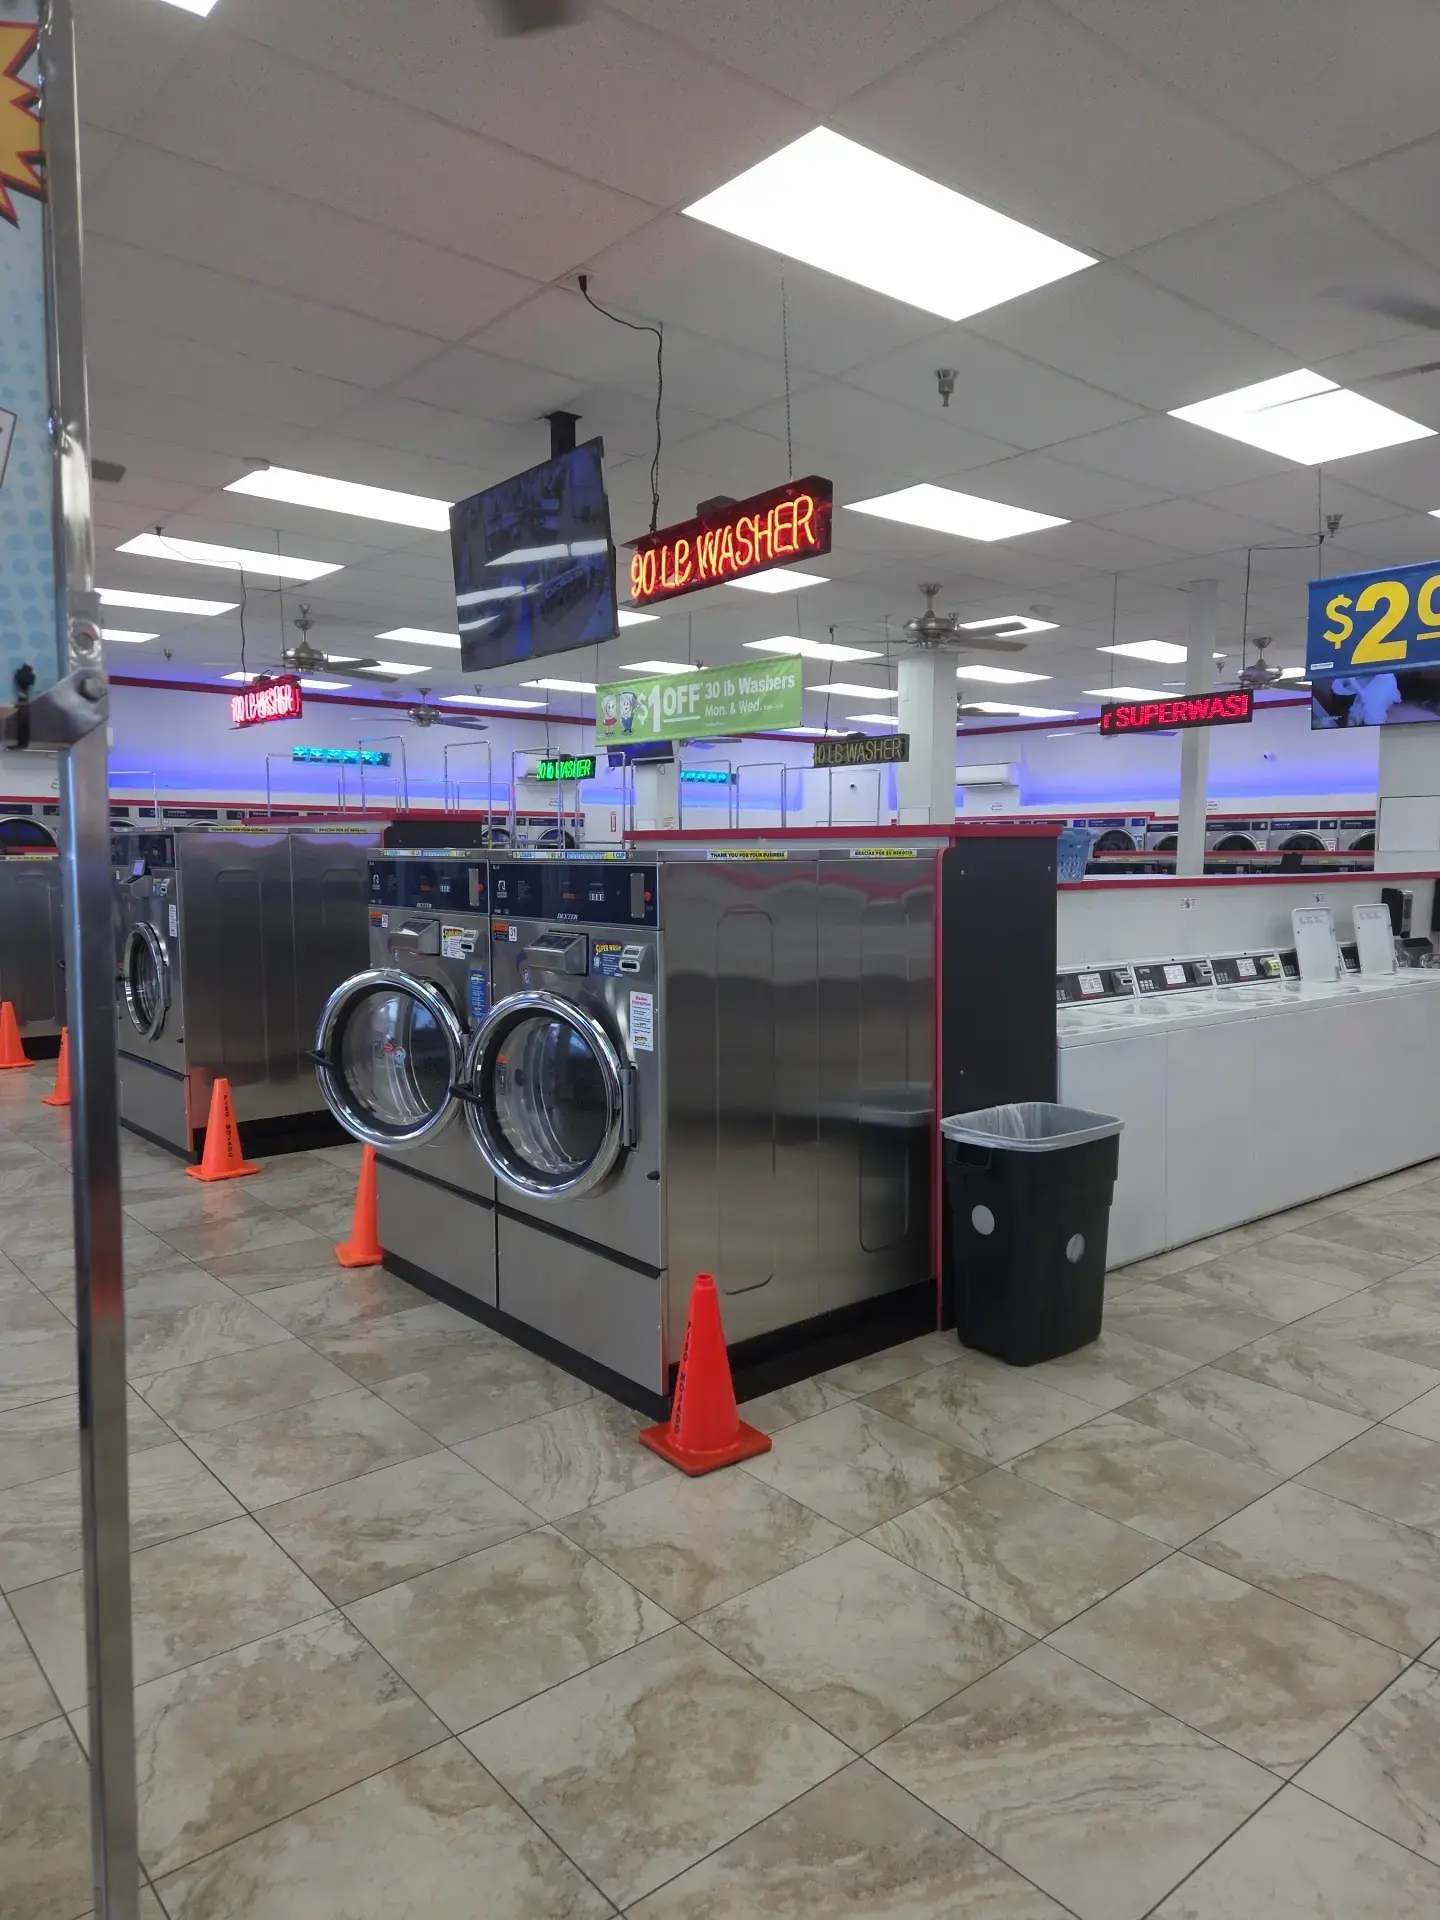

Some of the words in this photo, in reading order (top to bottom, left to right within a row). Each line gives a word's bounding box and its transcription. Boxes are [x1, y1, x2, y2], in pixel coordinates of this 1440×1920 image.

[630, 549, 657, 598] 90
[696, 494, 815, 579] WASHER
[705, 681, 721, 699] 30
[723, 678, 735, 697] lb
[738, 673, 795, 694] Washers
[705, 704, 728, 717] Mon.
[730, 702, 736, 714] &
[739, 698, 763, 714] Wed.
[828, 744, 842, 763] LB
[846, 737, 902, 761] WASHER
[557, 913, 579, 921] DEXTER
[510, 927, 516, 937] 31
[682, 1320, 692, 1363] PISO
[674, 1371, 686, 1434] MOJADO
